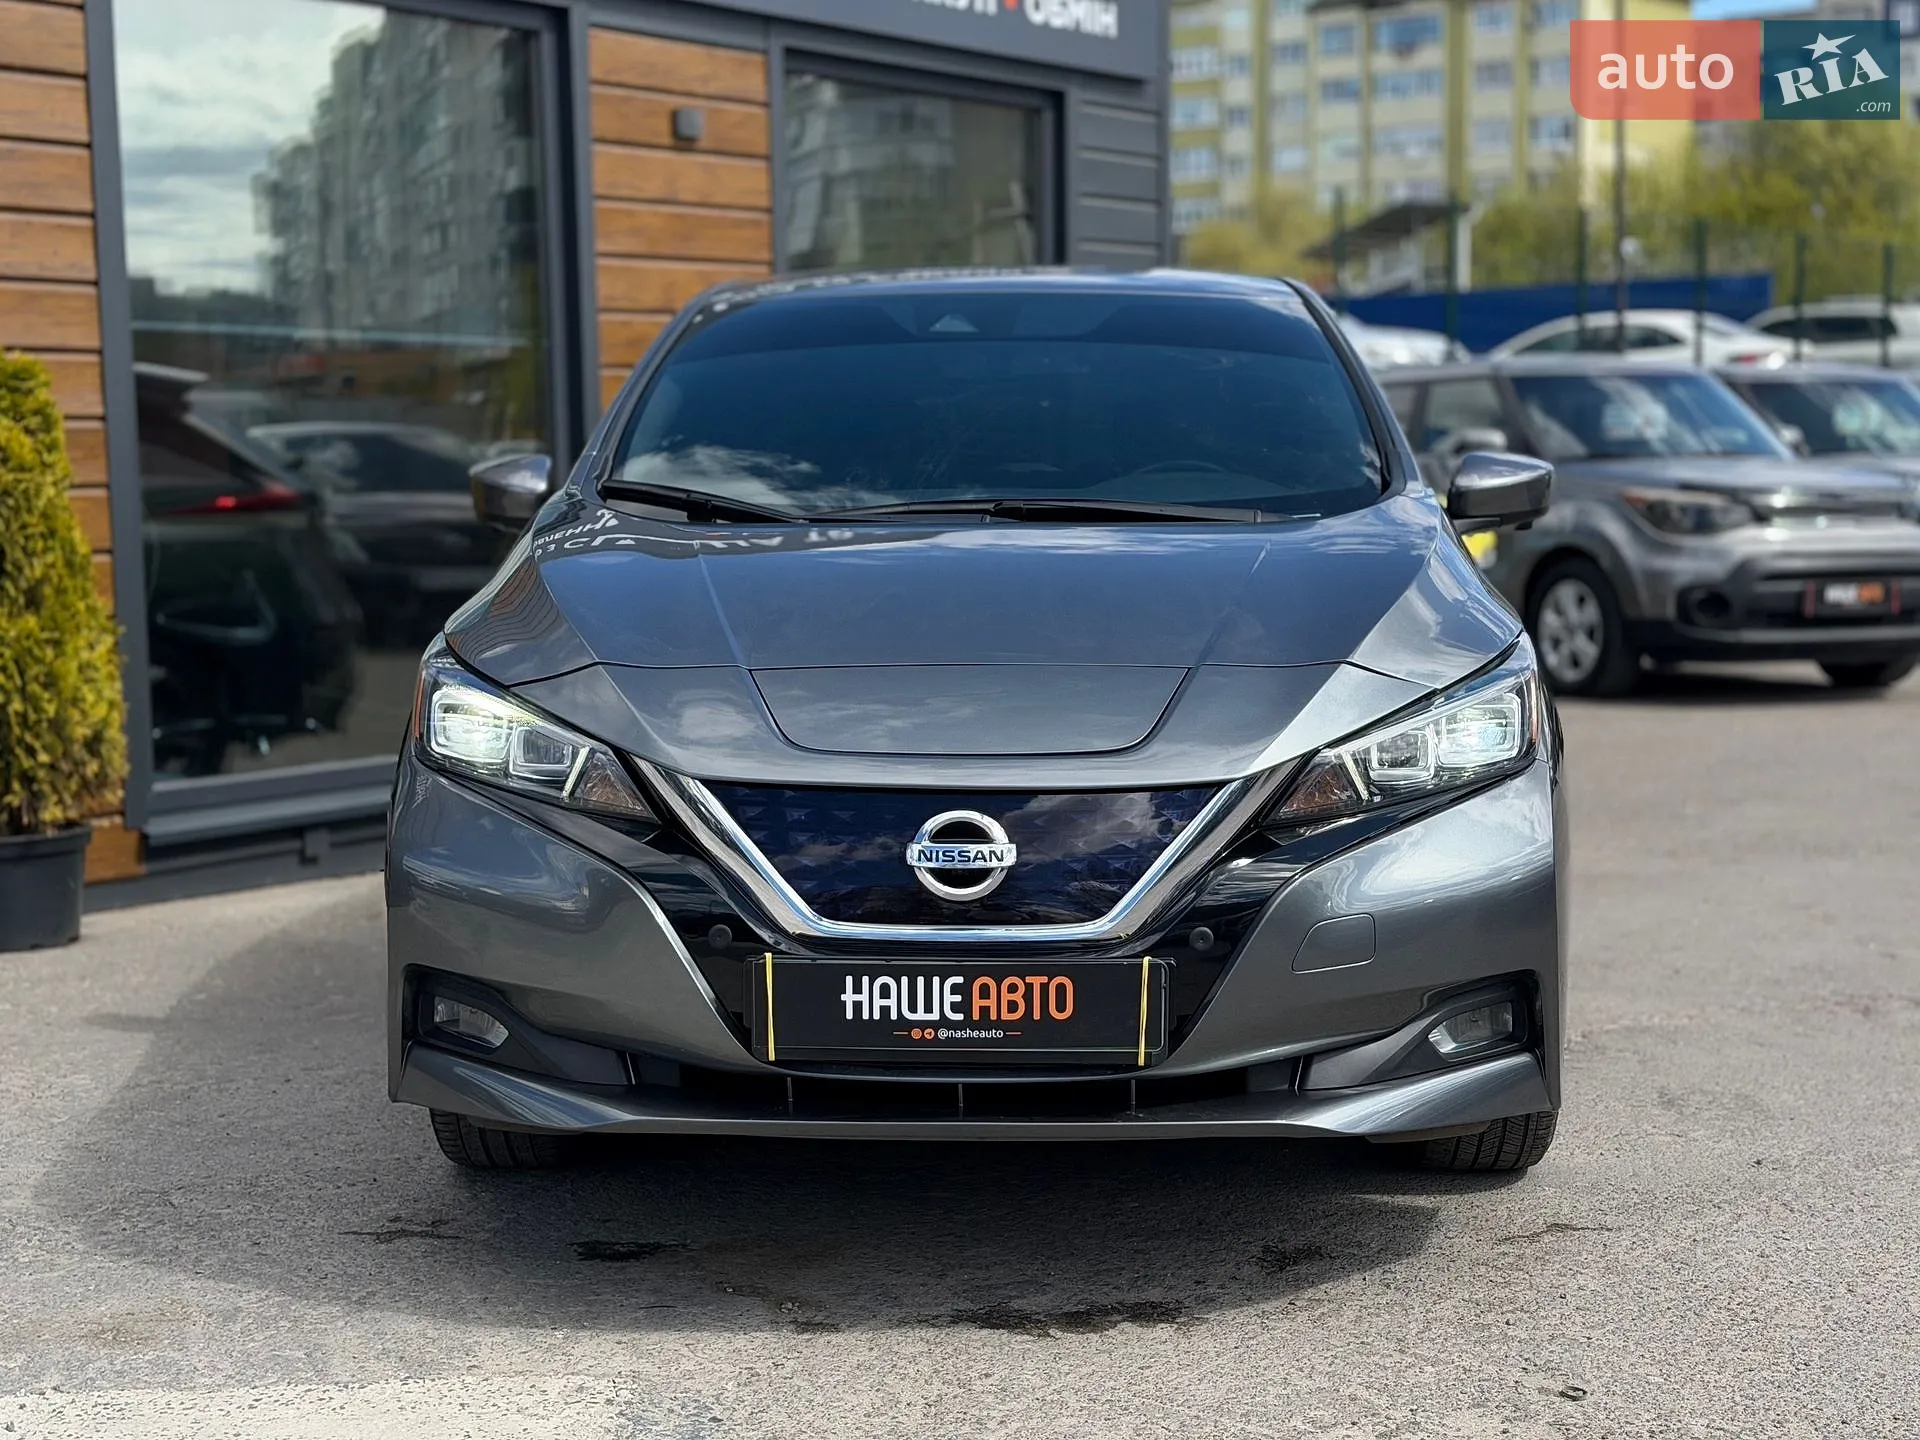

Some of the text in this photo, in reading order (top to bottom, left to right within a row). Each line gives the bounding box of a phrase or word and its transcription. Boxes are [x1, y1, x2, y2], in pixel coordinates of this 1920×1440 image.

[917, 849, 1004, 863] NISSAN
[841, 975, 1074, 1021] НАШЕ АВТО
[937, 1027, 1004, 1040] @nasheauto
